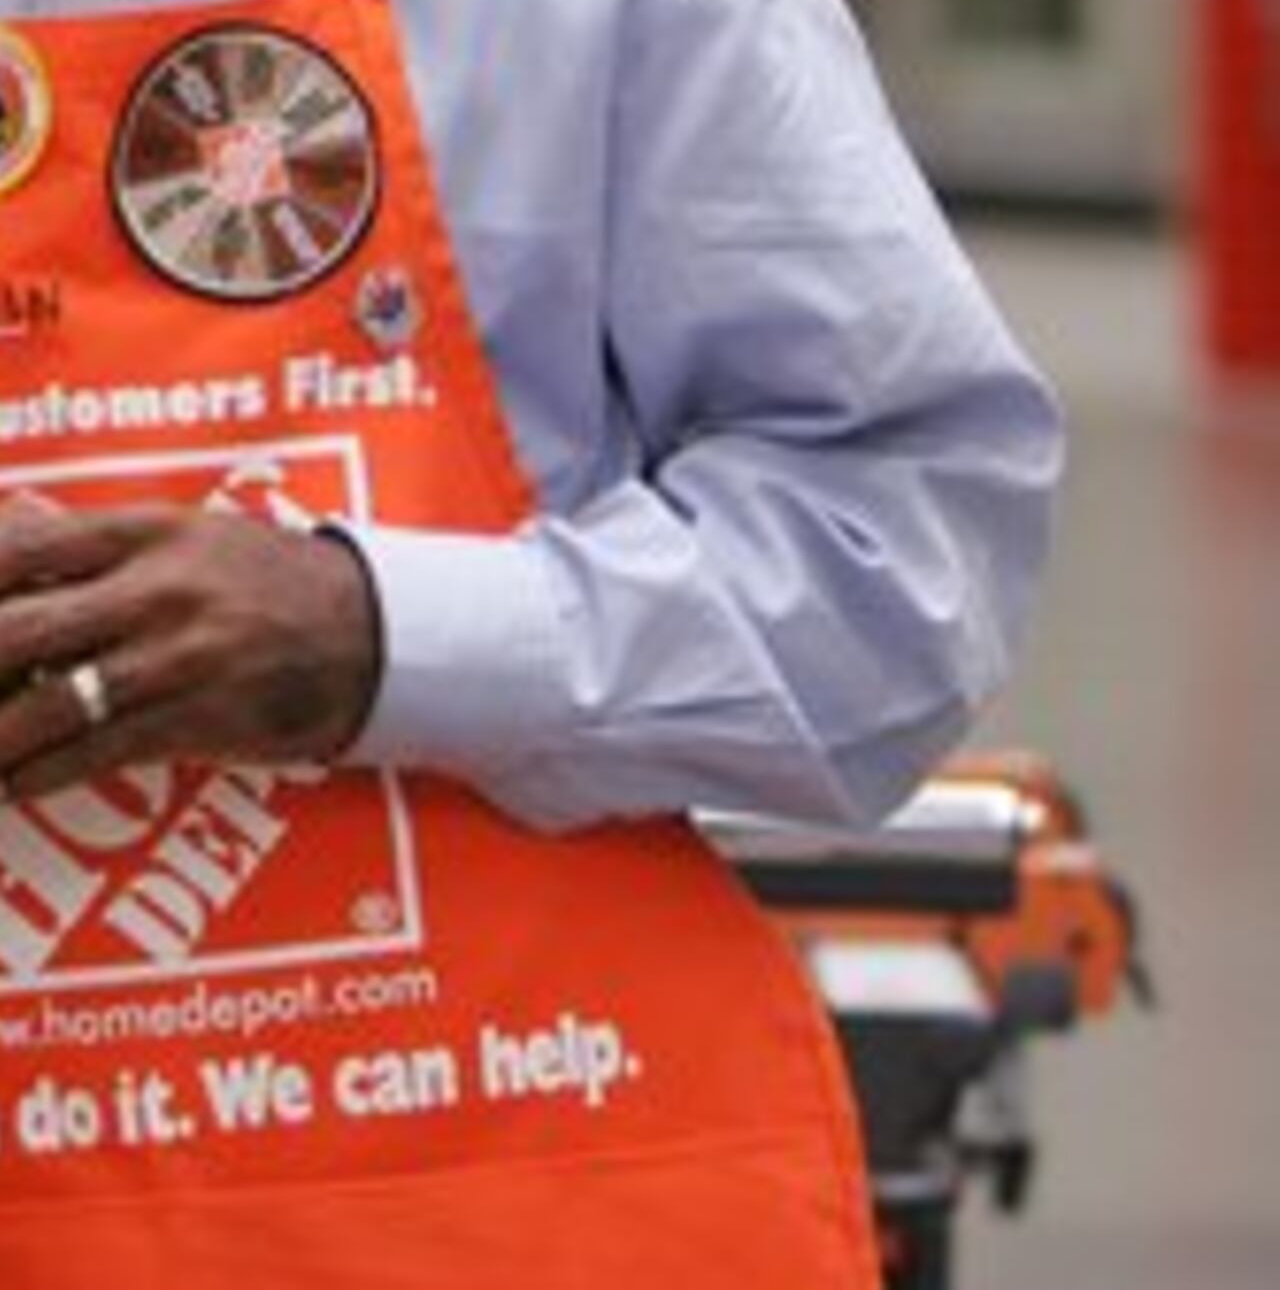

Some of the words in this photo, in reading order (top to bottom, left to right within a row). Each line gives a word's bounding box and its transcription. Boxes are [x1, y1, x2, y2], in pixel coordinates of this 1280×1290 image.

[283, 352, 438, 410] First.
[17, 1075, 101, 1152] do
[116, 1067, 197, 1146] it.
[200, 1050, 316, 1131] We
[334, 1042, 460, 1114] can
[479, 1008, 642, 1106] help.
